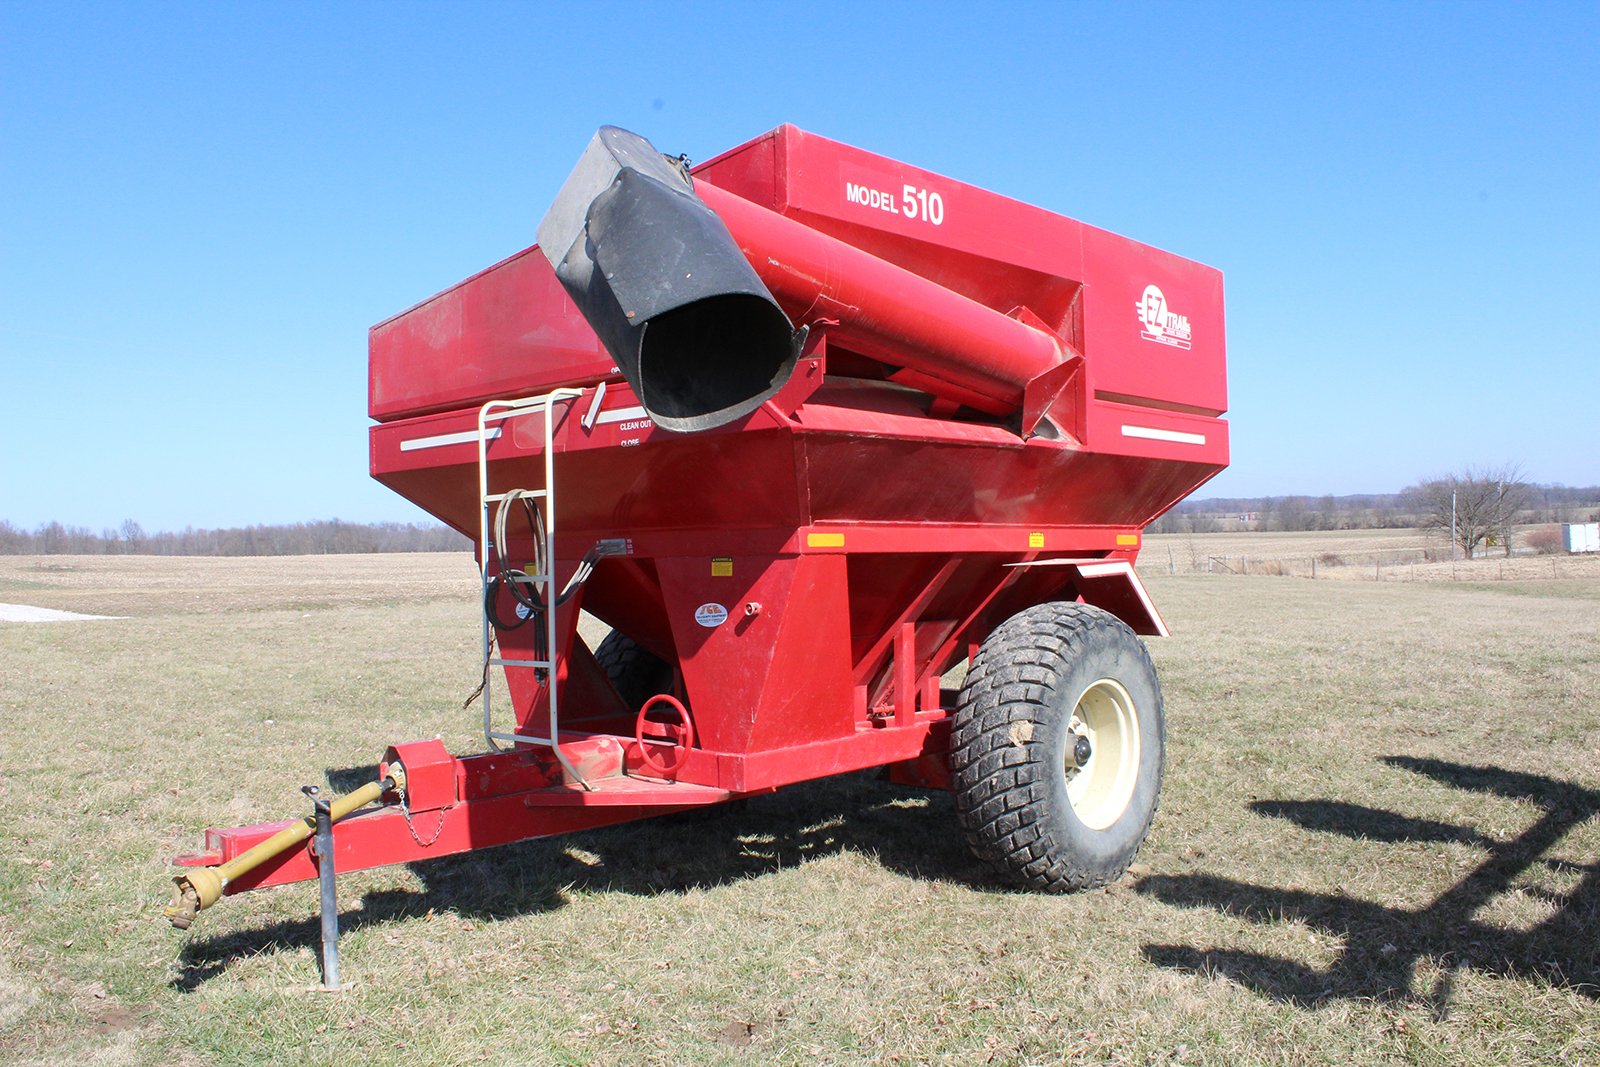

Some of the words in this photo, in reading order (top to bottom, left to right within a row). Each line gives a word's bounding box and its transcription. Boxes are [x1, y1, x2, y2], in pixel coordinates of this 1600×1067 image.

[846, 181, 899, 214] MODEL
[902, 183, 944, 226] 510
[620, 421, 639, 432] CLEAN
[640, 419, 652, 429] OUT
